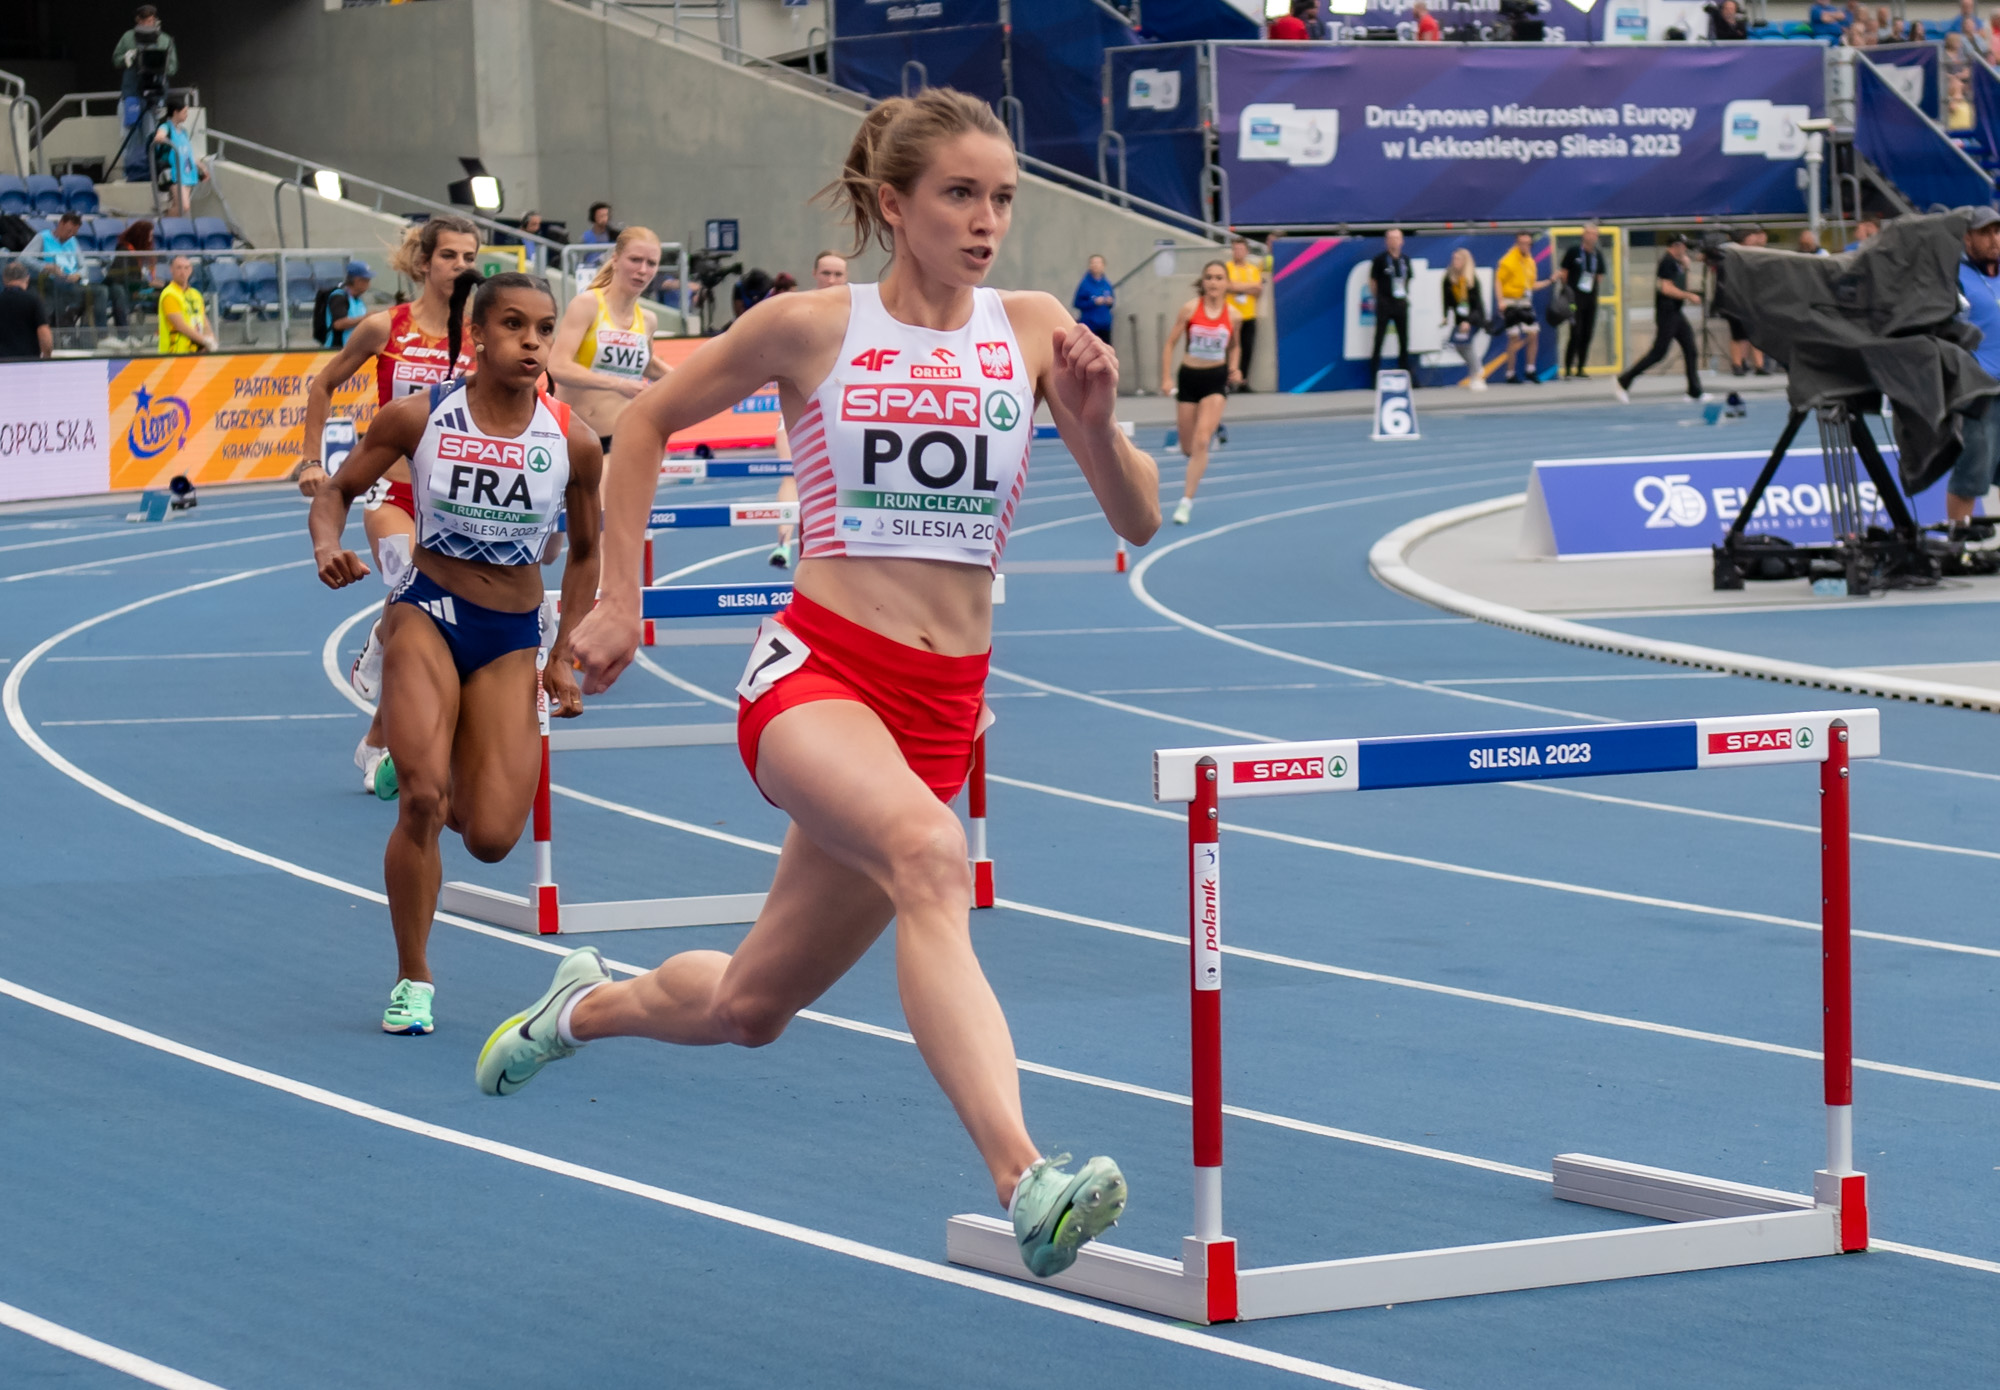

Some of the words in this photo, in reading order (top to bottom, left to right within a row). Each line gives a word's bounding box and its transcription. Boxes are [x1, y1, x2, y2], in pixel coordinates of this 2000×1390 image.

[1366, 103, 1488, 132] Drużynowe
[1493, 103, 1619, 127] Mistrzostwa
[1622, 103, 1697, 130] Europy
[1383, 141, 1404, 159] w
[1408, 136, 1557, 163] Lekkoatletyce
[1561, 133, 1628, 156] Silesia
[1631, 134, 1681, 157] 2023
[402, 346, 470, 366] ESPAA
[600, 346, 645, 369] SWE
[912, 366, 959, 378] ORLEN
[233, 375, 302, 398] PARTNER
[846, 388, 977, 422] SPAR
[1382, 396, 1411, 435] 6
[140, 408, 179, 446] LOTTO
[214, 408, 276, 431] IGRZYSK
[440, 437, 523, 467] SPAR
[863, 428, 999, 492] POL
[448, 464, 533, 511] FRA
[457, 505, 483, 519] RUN
[875, 493, 881, 507] I
[883, 493, 921, 510] RUN
[462, 521, 508, 537] SILESIA
[510, 526, 538, 537] 2023
[651, 512, 677, 524] 2023
[746, 509, 781, 520] SPAR
[892, 519, 967, 539] SILESIA
[972, 523, 994, 541] 20
[718, 593, 768, 608] SILESIA
[770, 591, 795, 605] 202
[747, 637, 792, 687] 7
[1253, 760, 1323, 779] SPAR
[1468, 746, 1541, 769] SILESIA
[1545, 743, 1592, 764] 2023
[1726, 731, 1791, 750] SPAR
[1201, 878, 1219, 952] polanik
